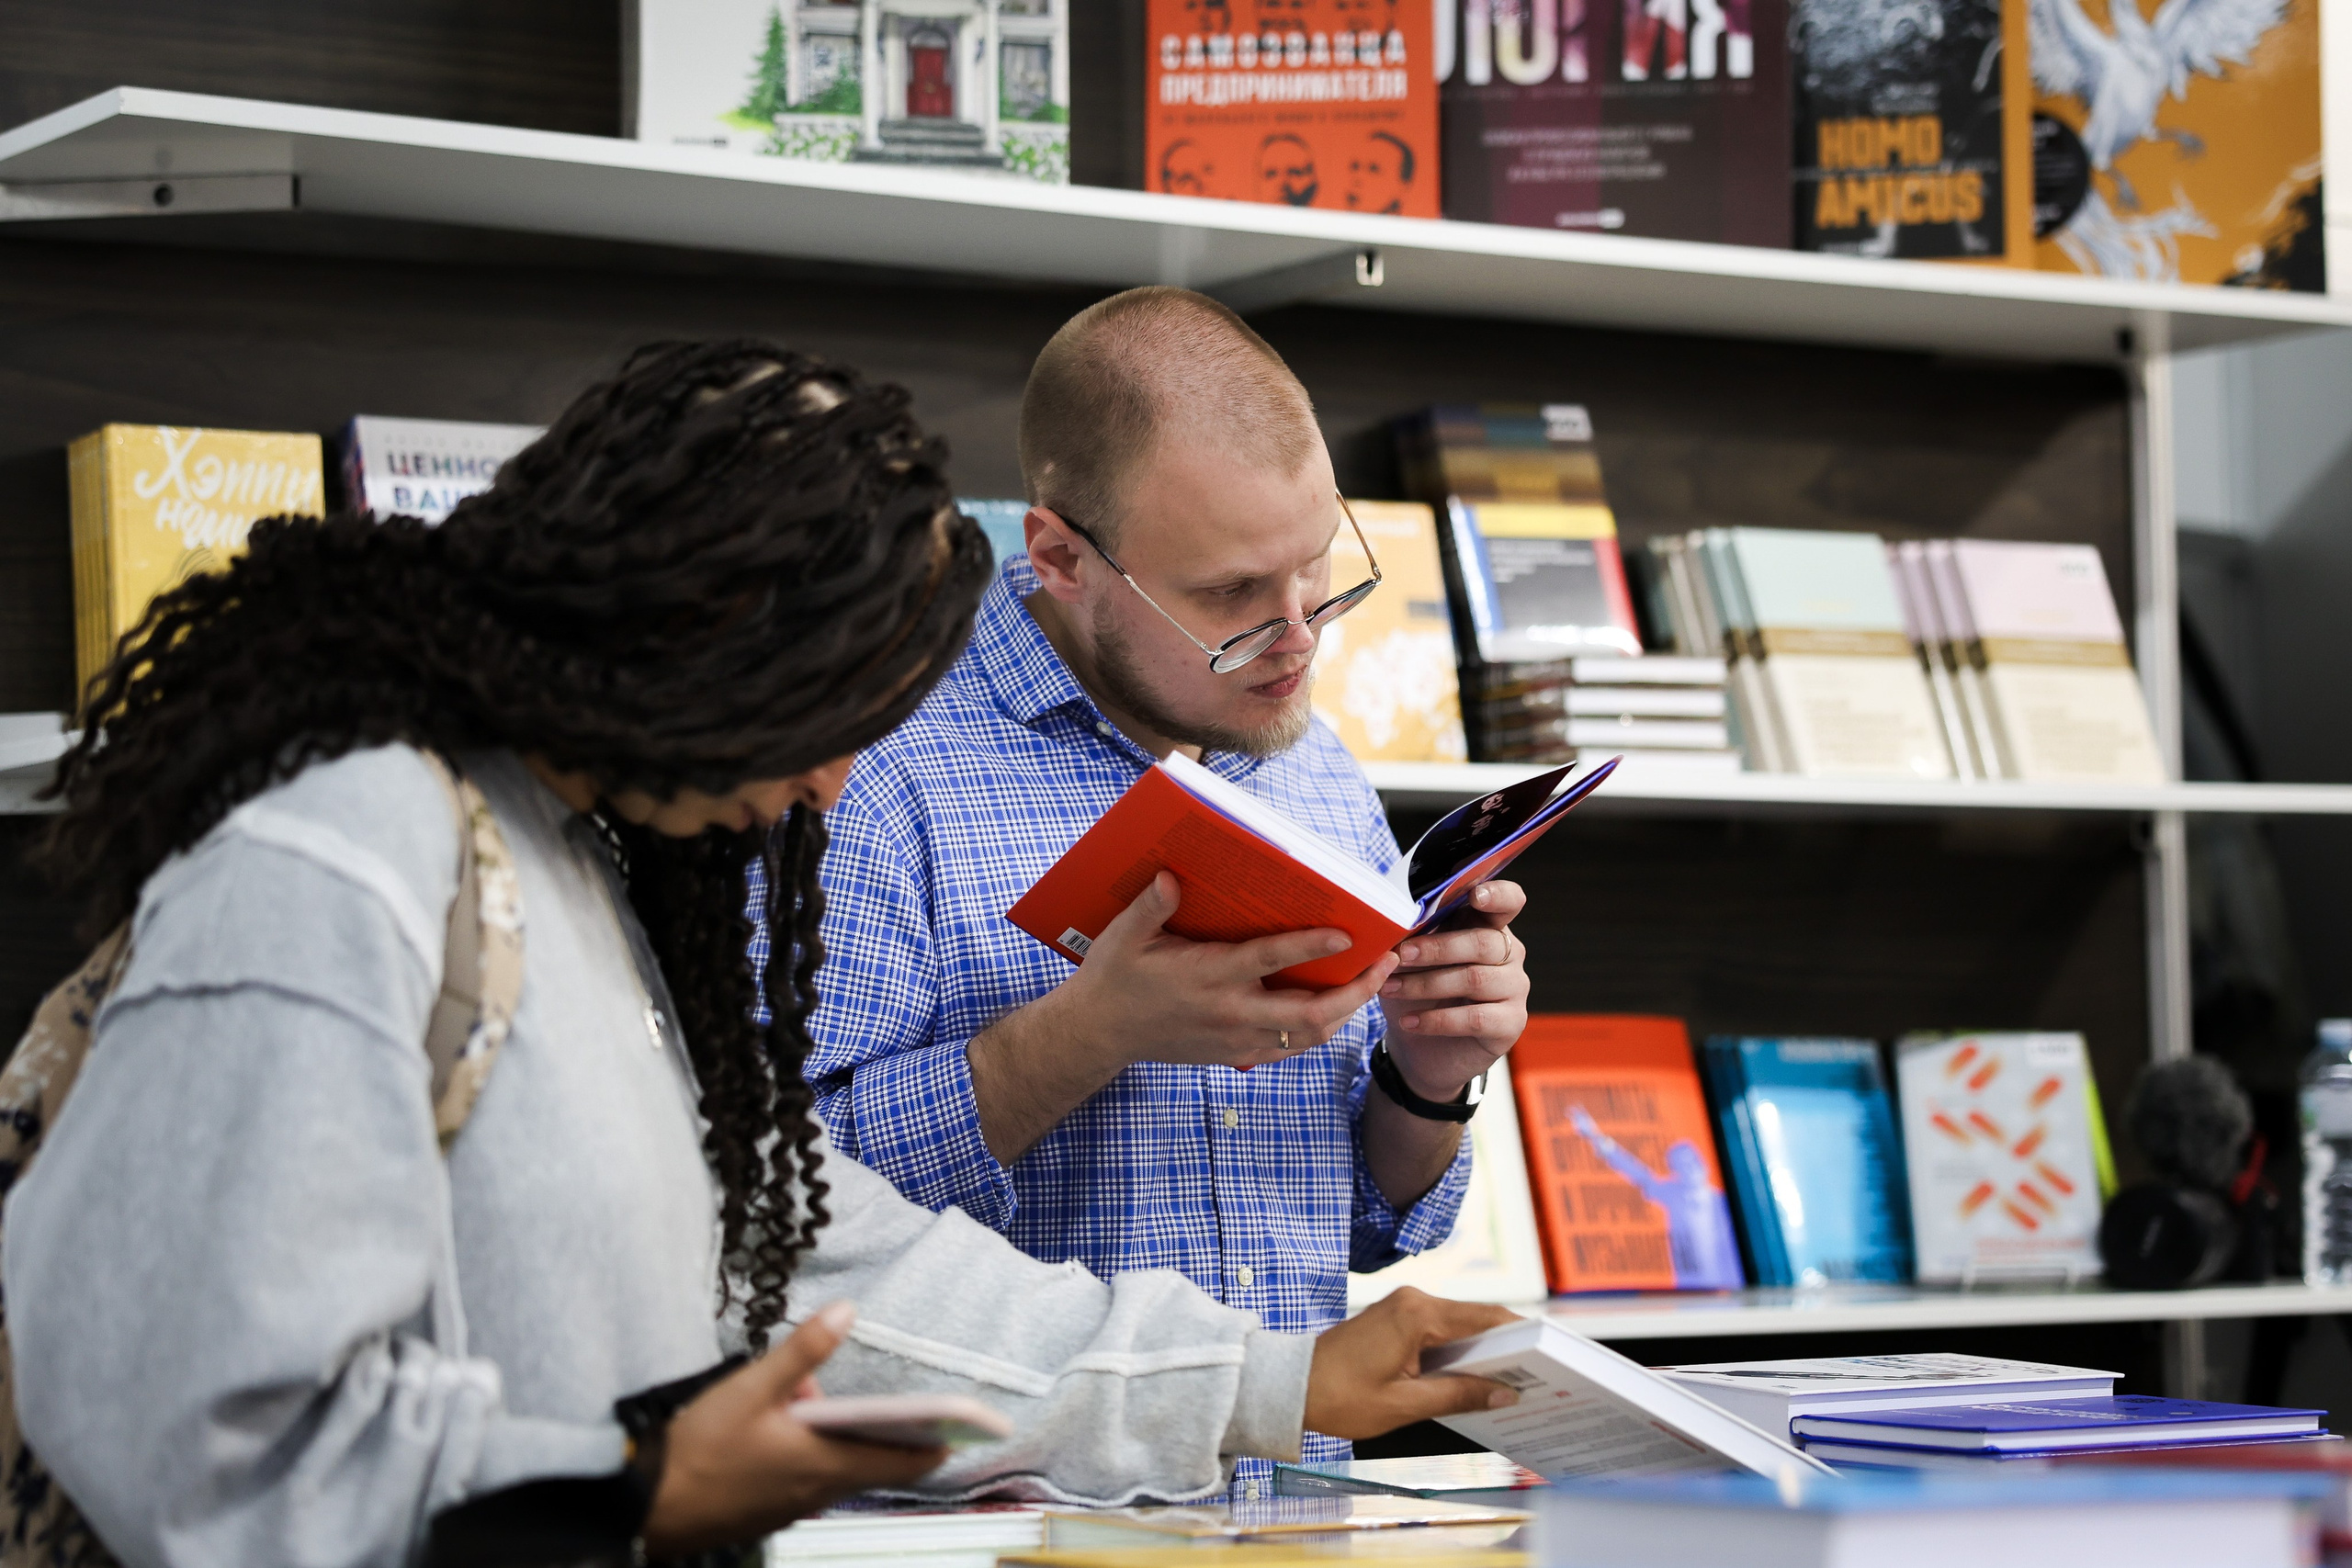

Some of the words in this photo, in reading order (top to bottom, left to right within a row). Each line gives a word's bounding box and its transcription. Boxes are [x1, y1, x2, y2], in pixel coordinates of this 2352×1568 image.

[1160, 30, 1407, 69] САМОЗВАНЦА
[1159, 70, 1408, 107] ПРЕДПРИНИМАТЕЛЯ
[1818, 116, 1943, 169] HOMO
[1815, 170, 1984, 228] AMICUS
[133, 425, 321, 511] Хэппи
